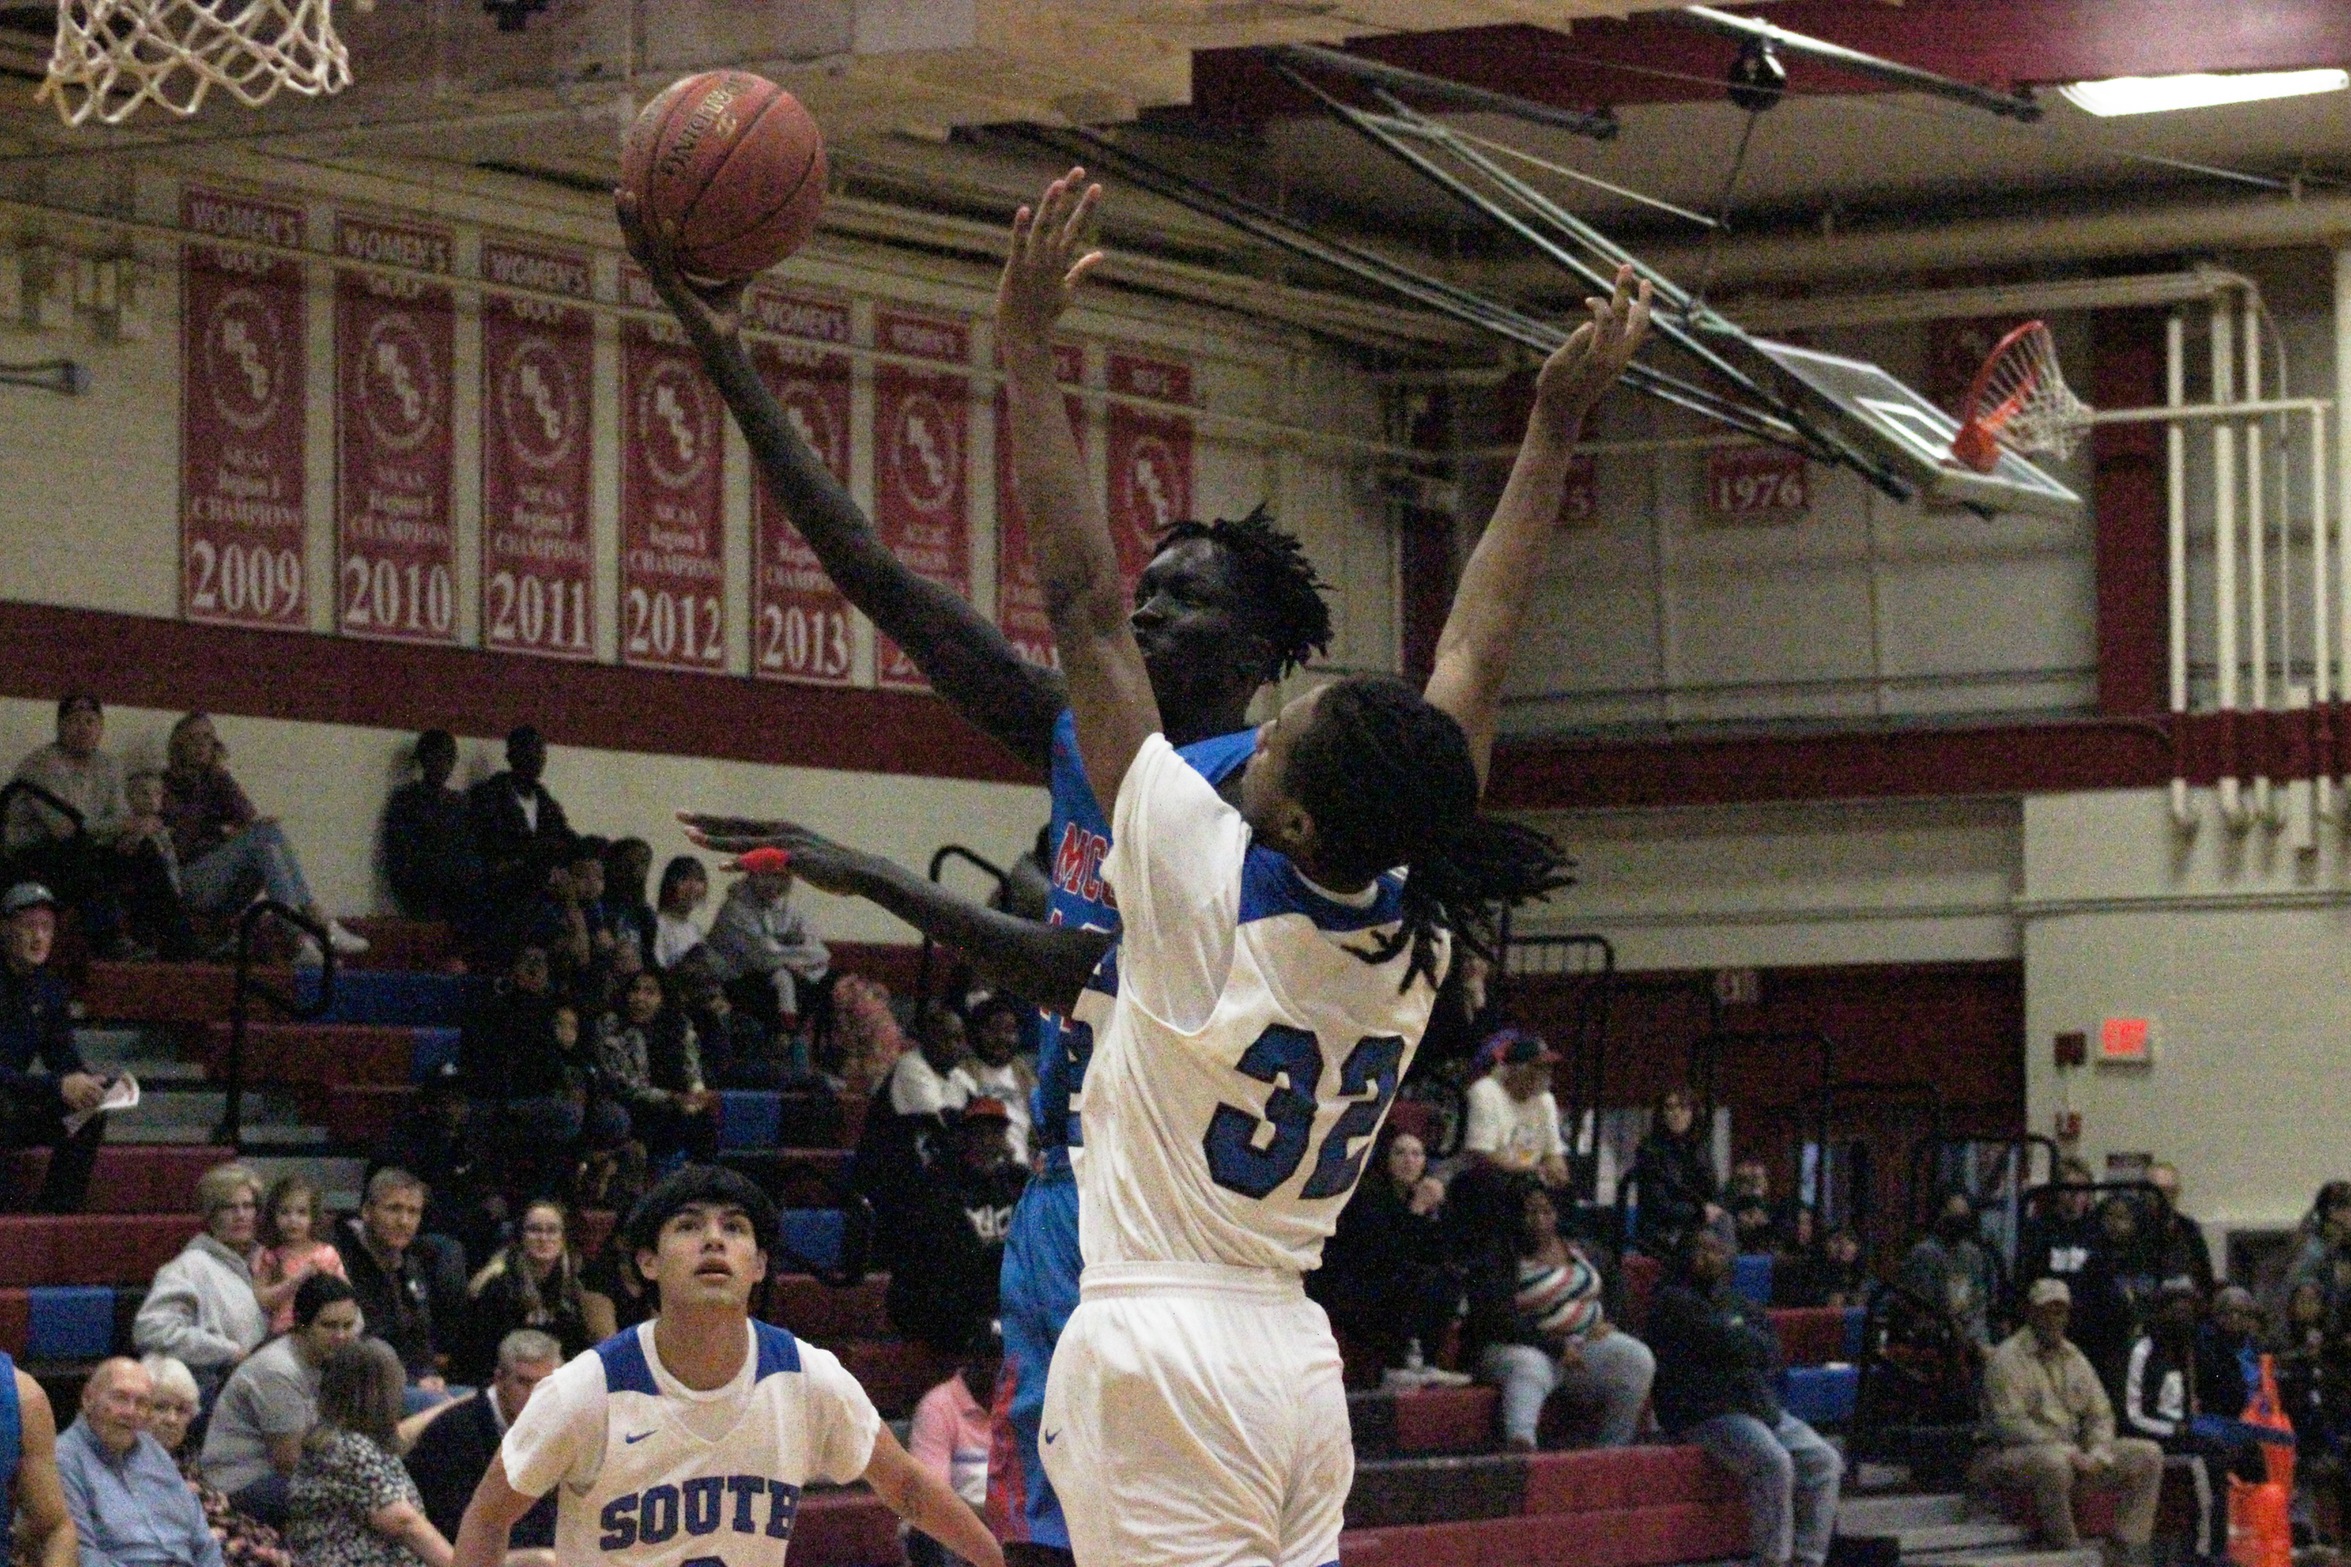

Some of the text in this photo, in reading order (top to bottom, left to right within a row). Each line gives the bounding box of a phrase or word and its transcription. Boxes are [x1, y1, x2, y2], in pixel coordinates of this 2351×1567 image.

[1718, 469, 1803, 511] 1976
[191, 539, 302, 617] 2009
[343, 554, 452, 632] 2010
[491, 570, 590, 648] 2011
[628, 587, 723, 661] 2012
[760, 603, 849, 675] 2013
[1053, 820, 1118, 910] MC
[1202, 1022, 1405, 1200] 32
